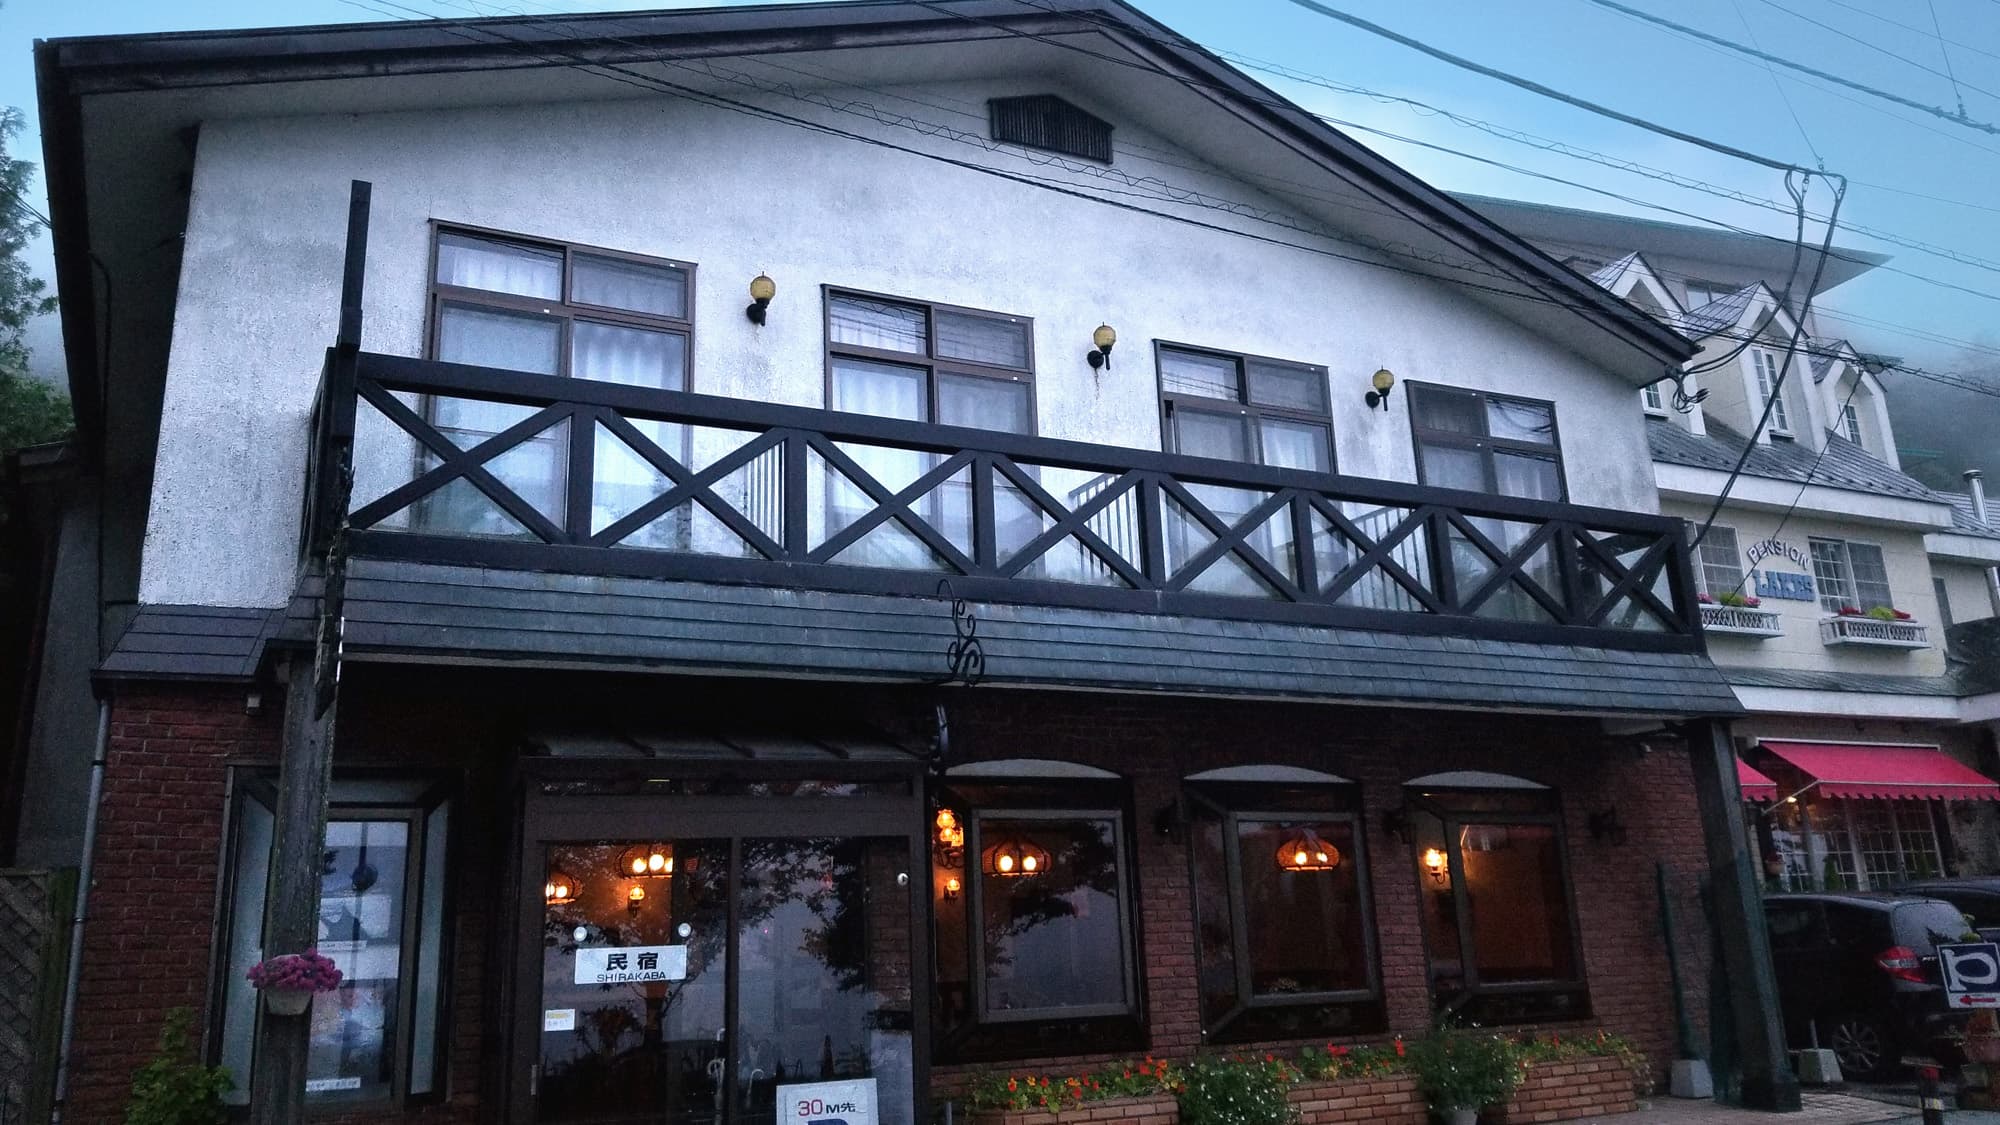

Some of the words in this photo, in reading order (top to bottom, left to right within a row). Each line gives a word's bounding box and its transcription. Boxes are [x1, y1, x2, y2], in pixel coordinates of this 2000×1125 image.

[1747, 539, 1809, 570] PENSION
[606, 952, 659, 971] 民宿
[1942, 949, 1998, 991] P
[596, 971, 667, 983] SHIRAKABA
